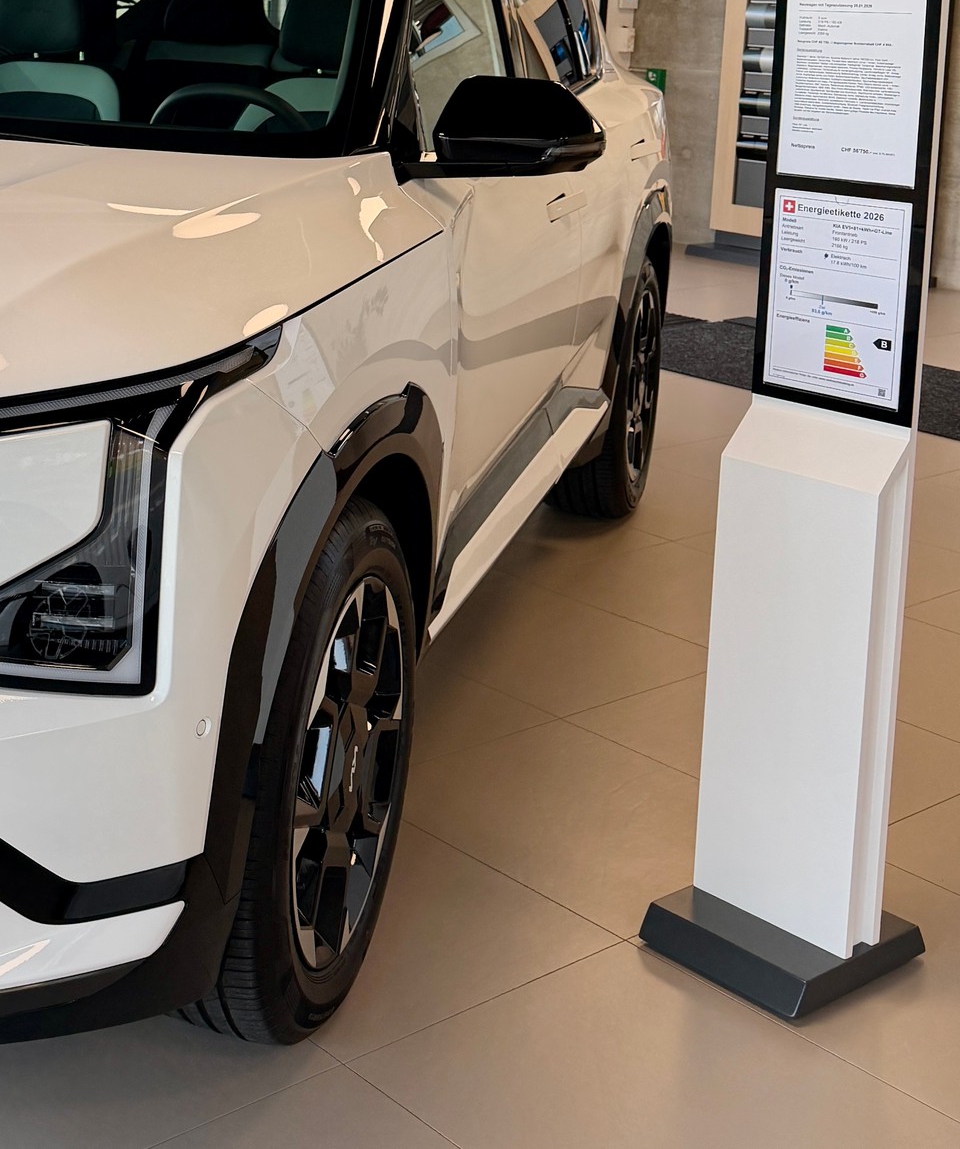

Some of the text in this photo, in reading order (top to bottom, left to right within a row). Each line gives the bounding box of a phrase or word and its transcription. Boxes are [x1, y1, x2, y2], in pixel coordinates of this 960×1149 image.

[798, 203, 884, 221] Energieetikette 2026
[881, 341, 888, 349] B
